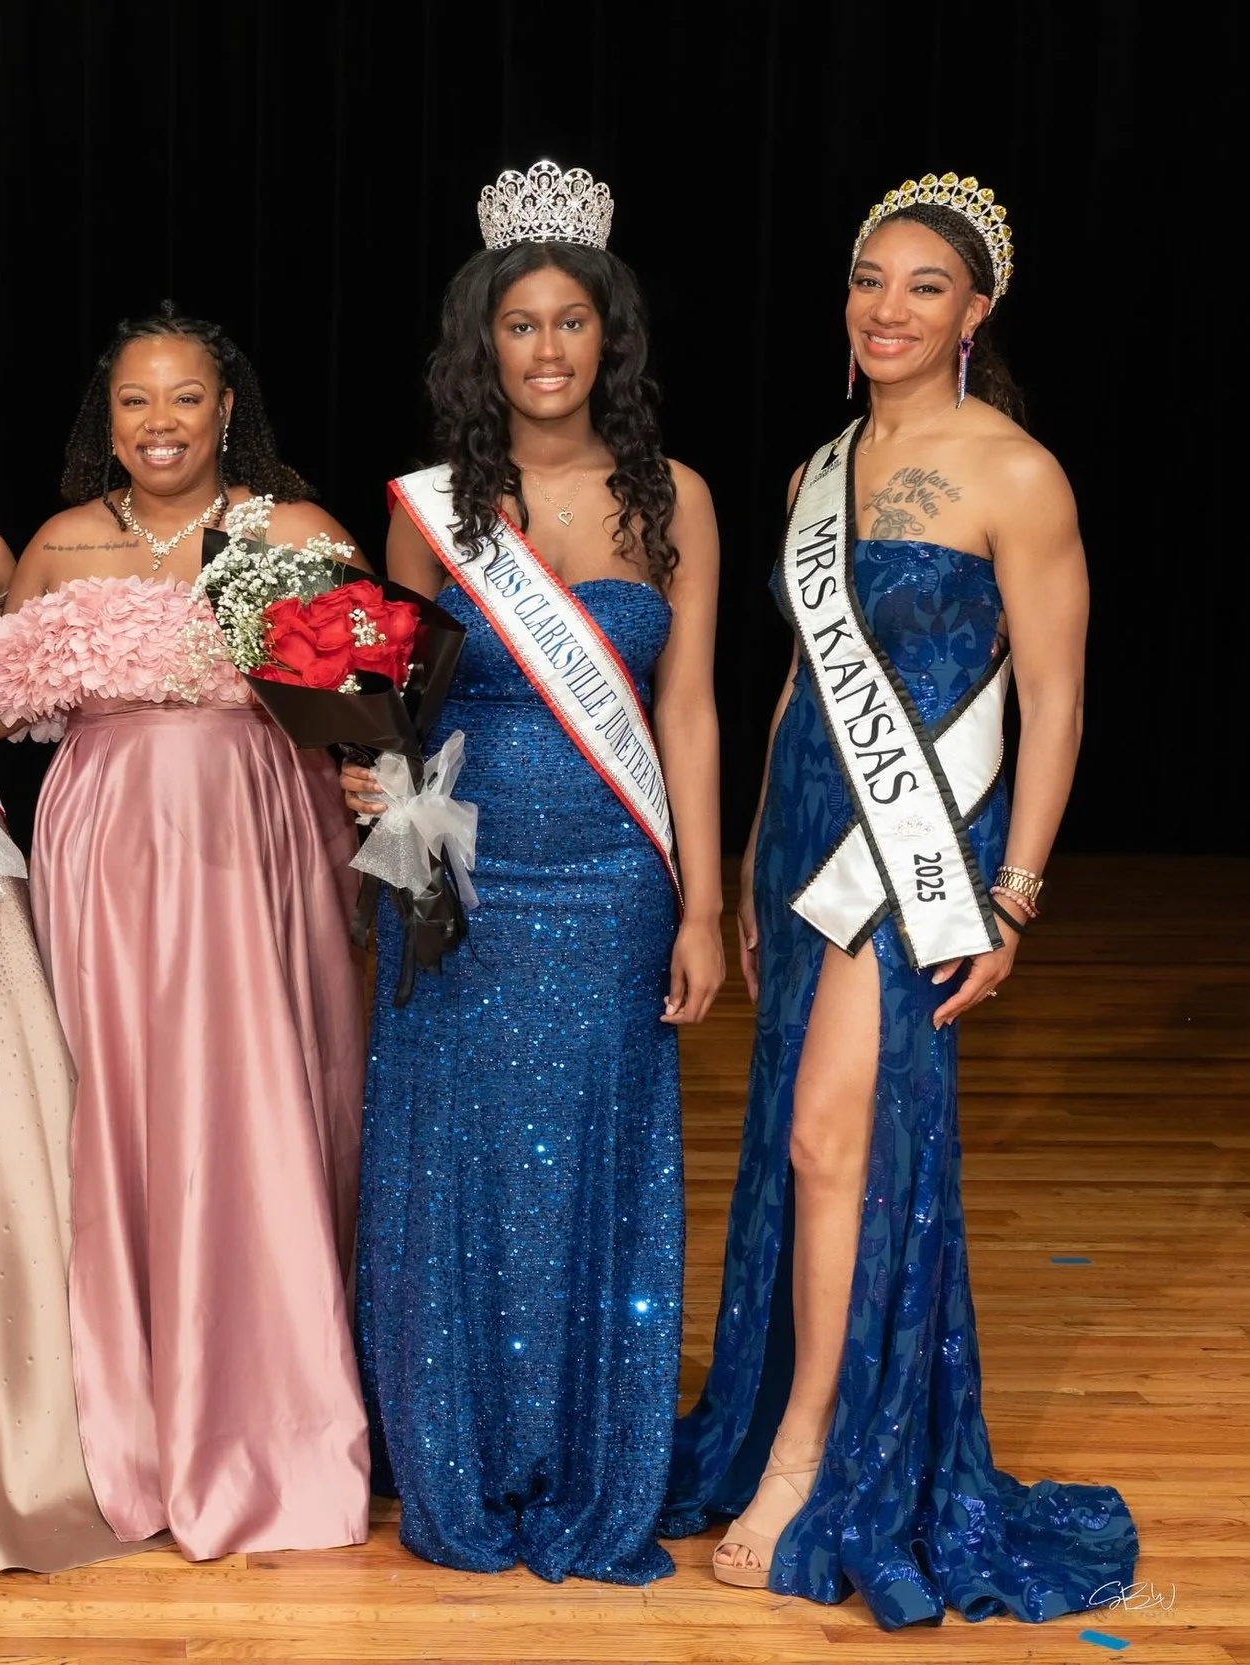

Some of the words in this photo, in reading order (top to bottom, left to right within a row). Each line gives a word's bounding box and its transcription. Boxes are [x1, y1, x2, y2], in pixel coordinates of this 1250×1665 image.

[796, 514, 839, 610] MRS
[480, 551, 532, 597] MISS
[514, 593, 618, 718] CLARKSVILLE
[594, 706, 667, 820] JUNETEENTH
[812, 616, 919, 805] KANSAS
[913, 851, 946, 903] 2025
